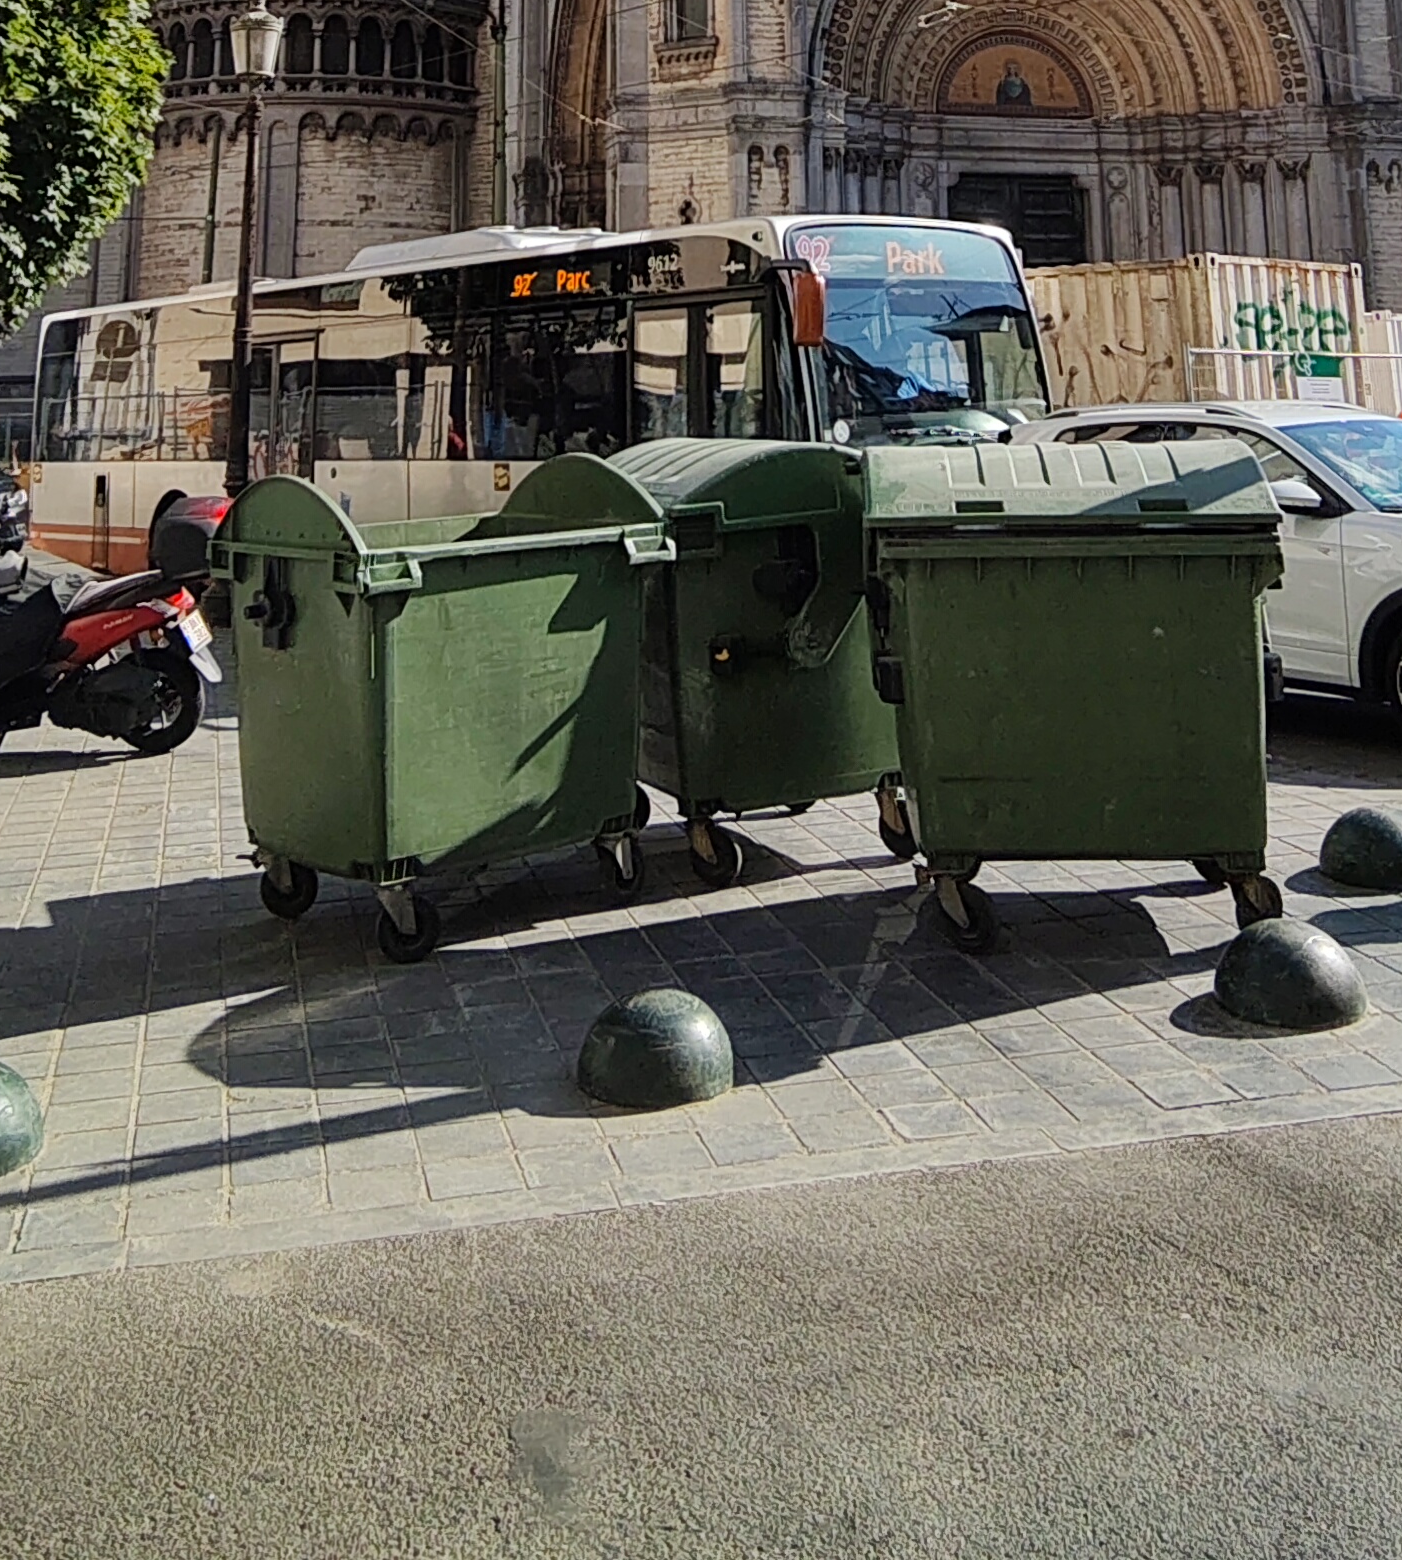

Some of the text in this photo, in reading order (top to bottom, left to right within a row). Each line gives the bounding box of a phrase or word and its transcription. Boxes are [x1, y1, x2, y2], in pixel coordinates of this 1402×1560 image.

[647, 253, 679, 273] 9612
[795, 234, 945, 274] 92 Park
[556, 269, 590, 292] Parc
